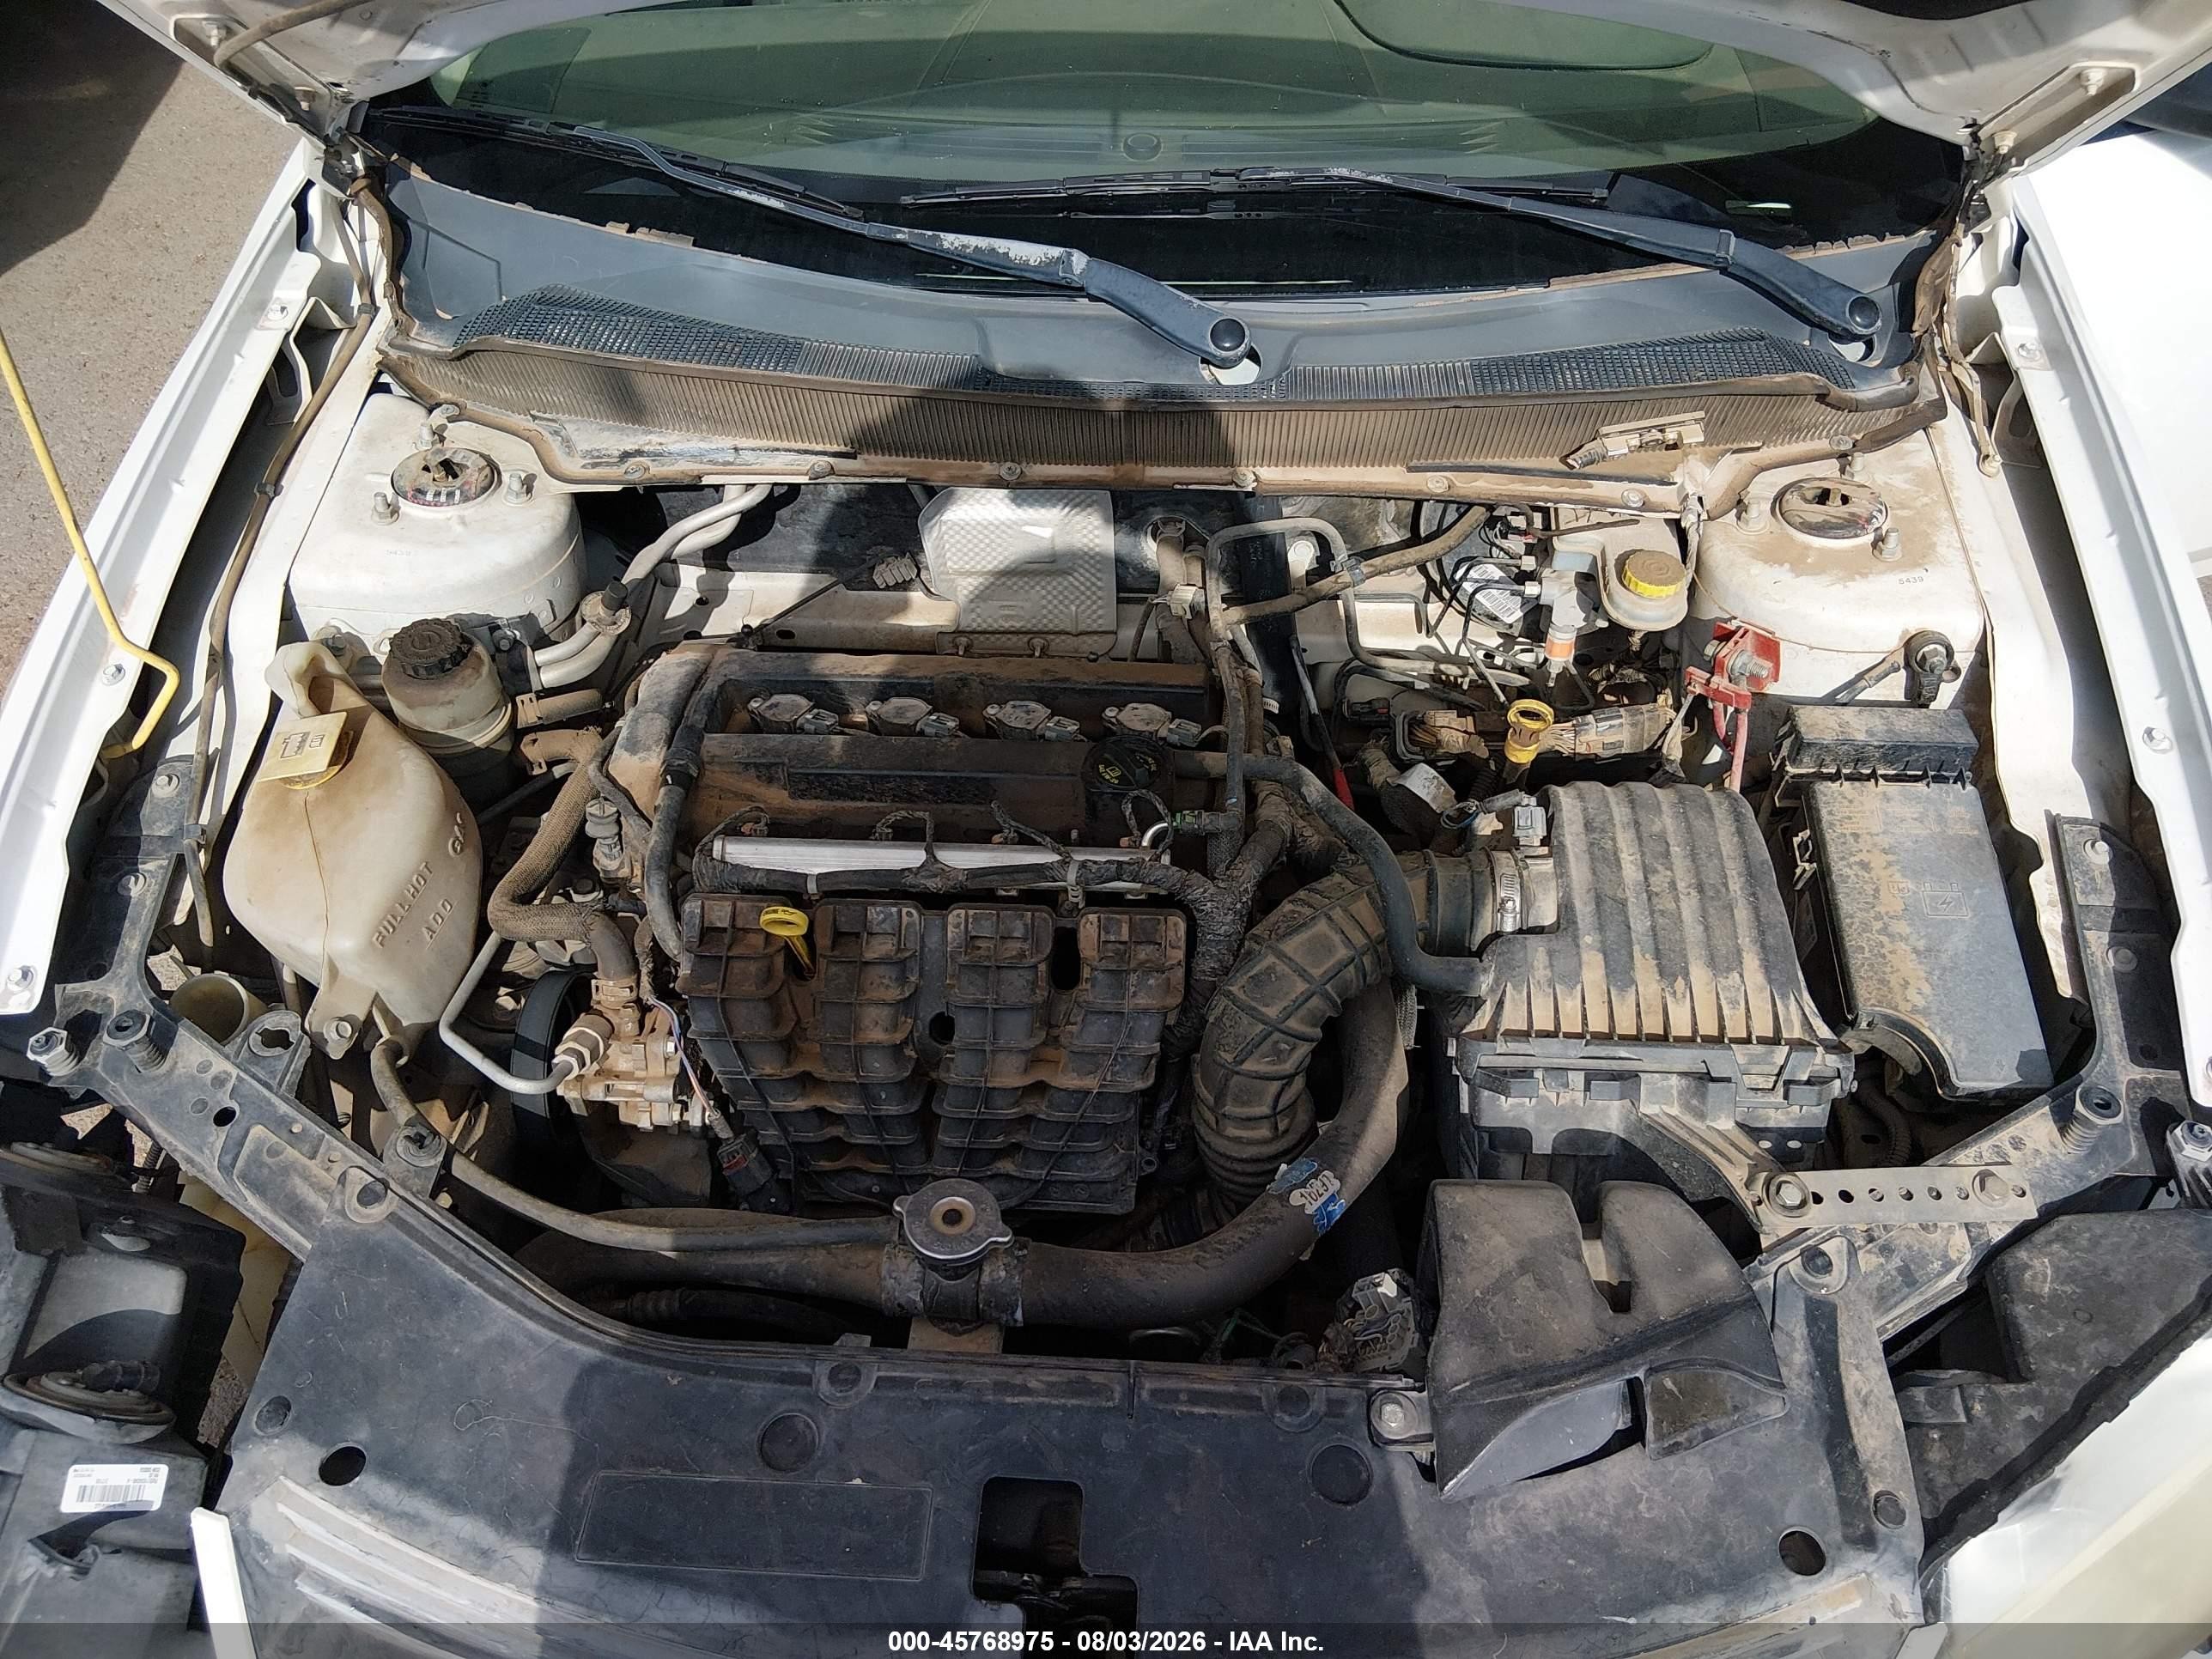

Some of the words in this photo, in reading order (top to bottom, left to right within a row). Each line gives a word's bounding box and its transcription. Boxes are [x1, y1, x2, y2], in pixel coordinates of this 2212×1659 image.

[372, 902, 412, 948] FULL
[404, 860, 433, 898] HOT
[422, 898, 453, 940] ADD
